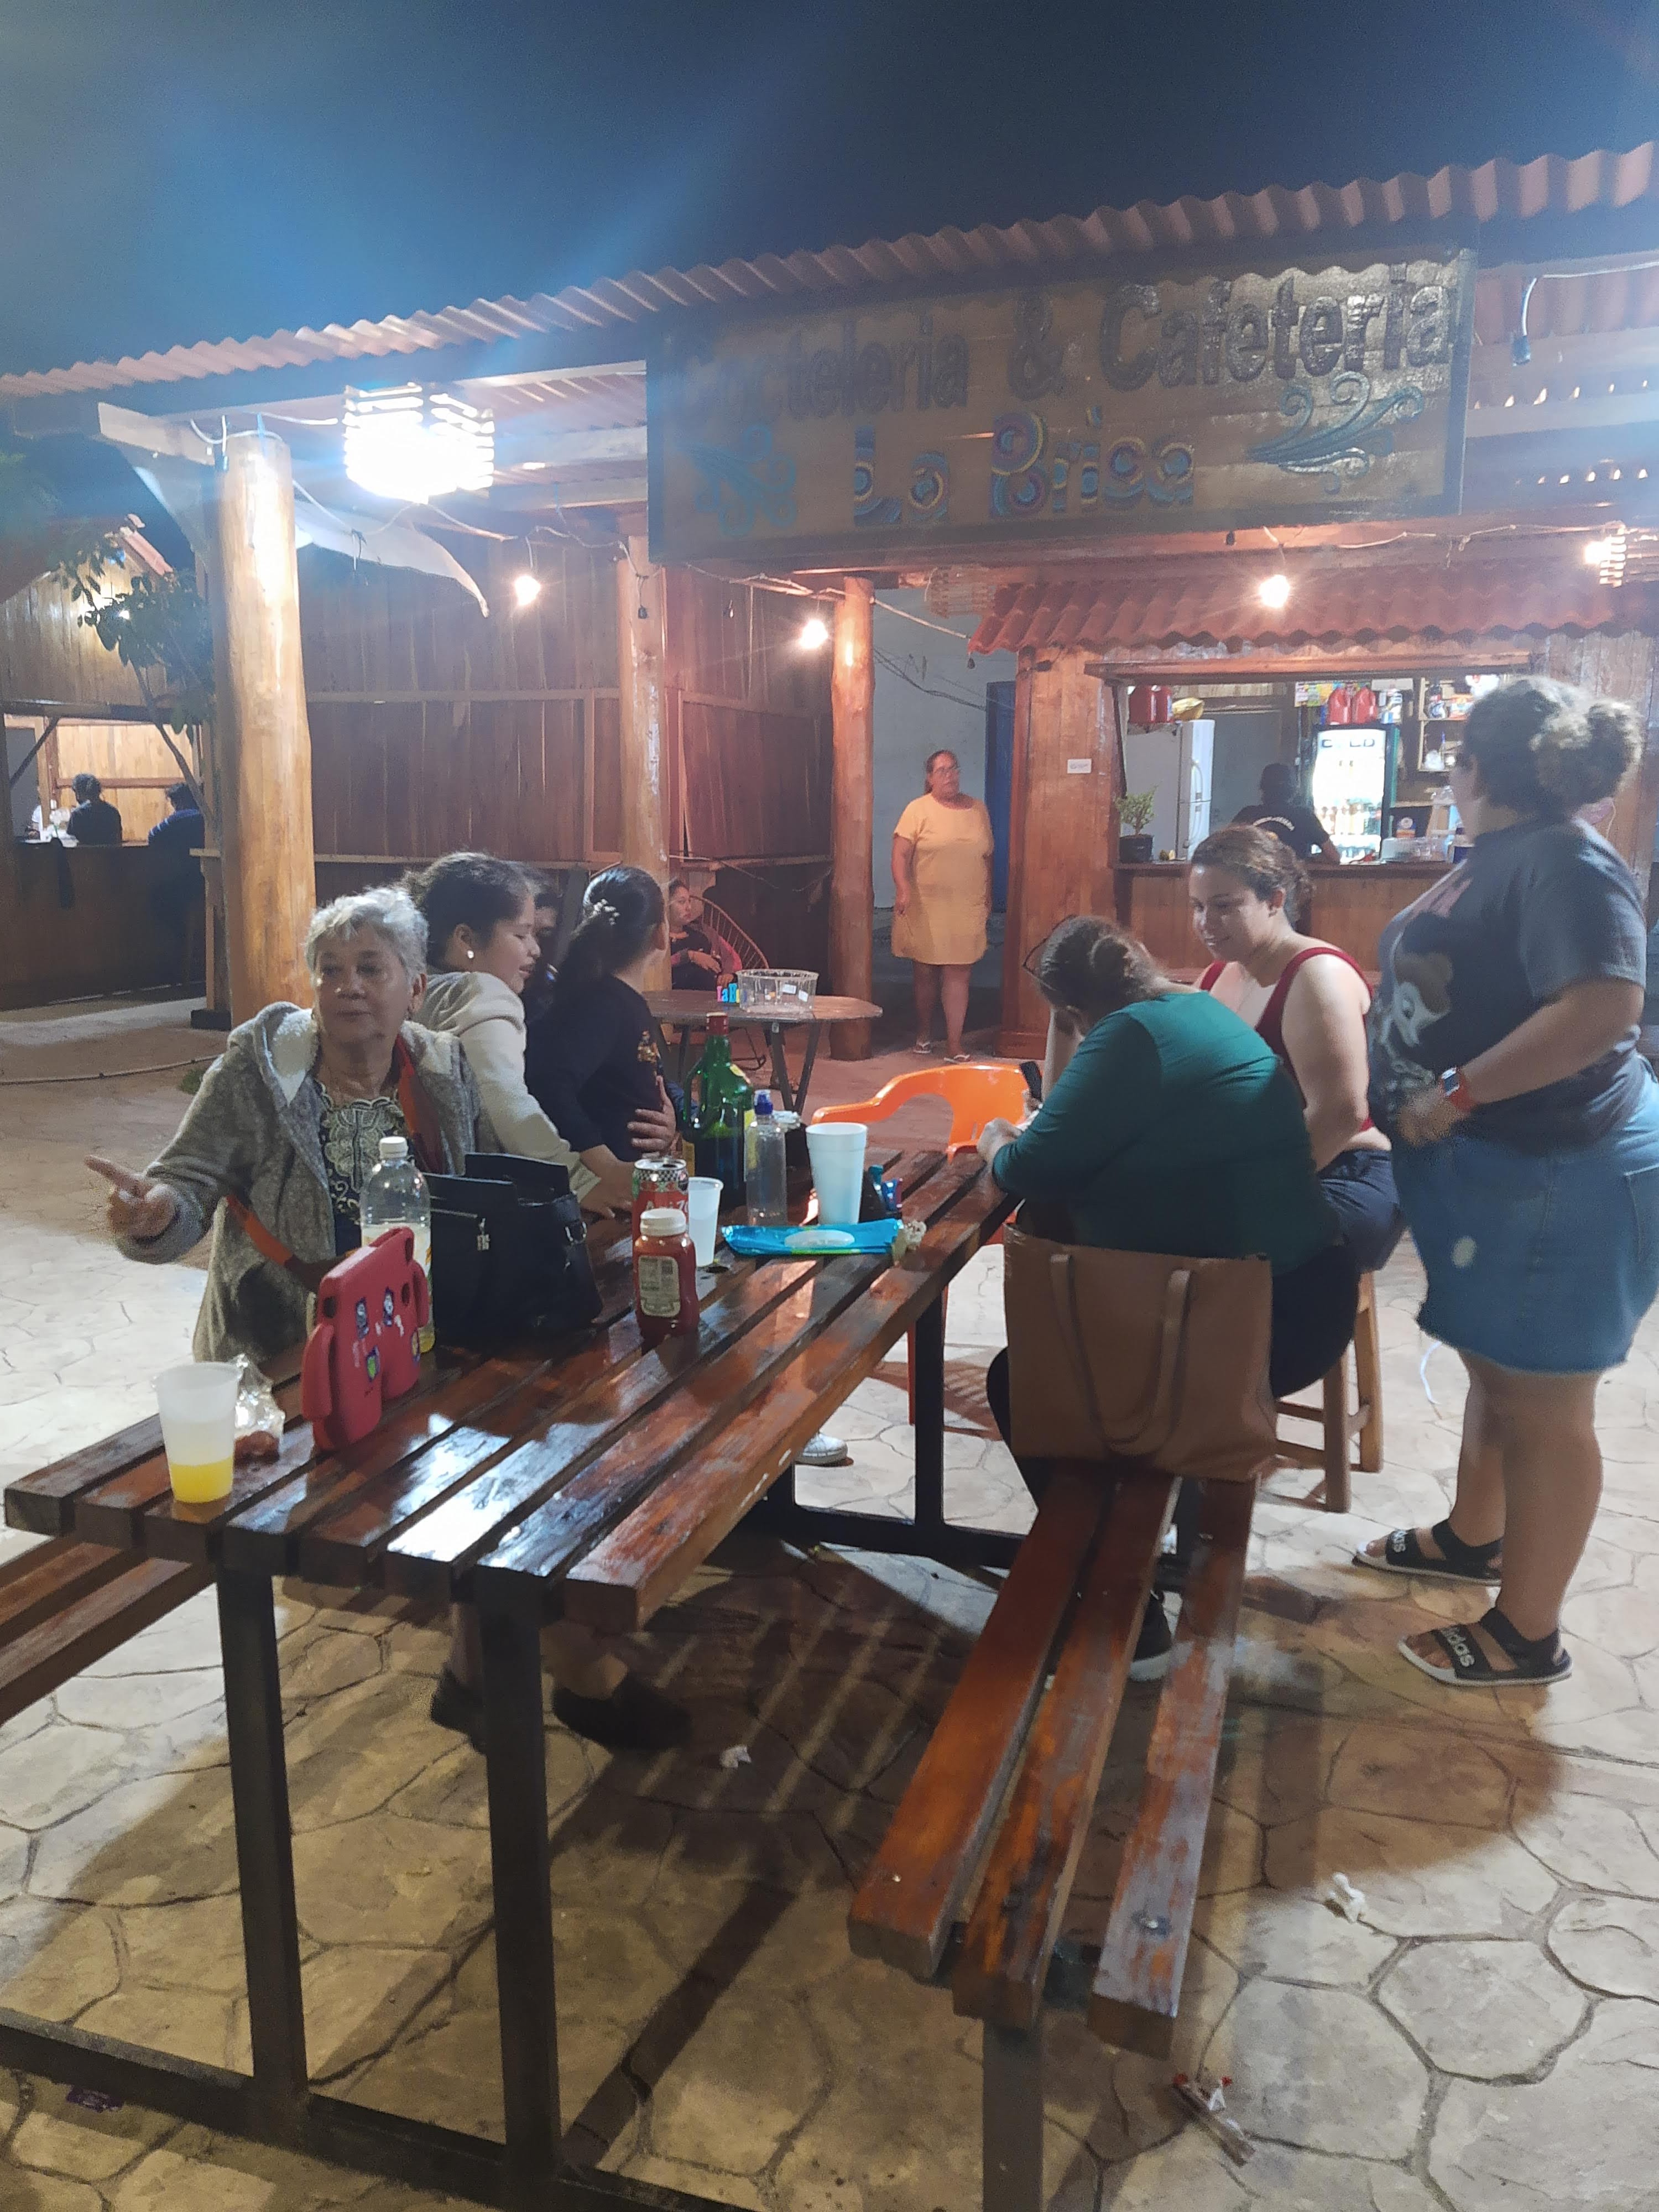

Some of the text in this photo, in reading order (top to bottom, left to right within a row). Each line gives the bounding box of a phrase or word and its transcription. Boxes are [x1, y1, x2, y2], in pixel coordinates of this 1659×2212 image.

[1007, 291, 1066, 401] &
[1099, 263, 1451, 392] Cafeteria
[854, 425, 951, 526] La
[1321, 738, 1376, 749] CLD
